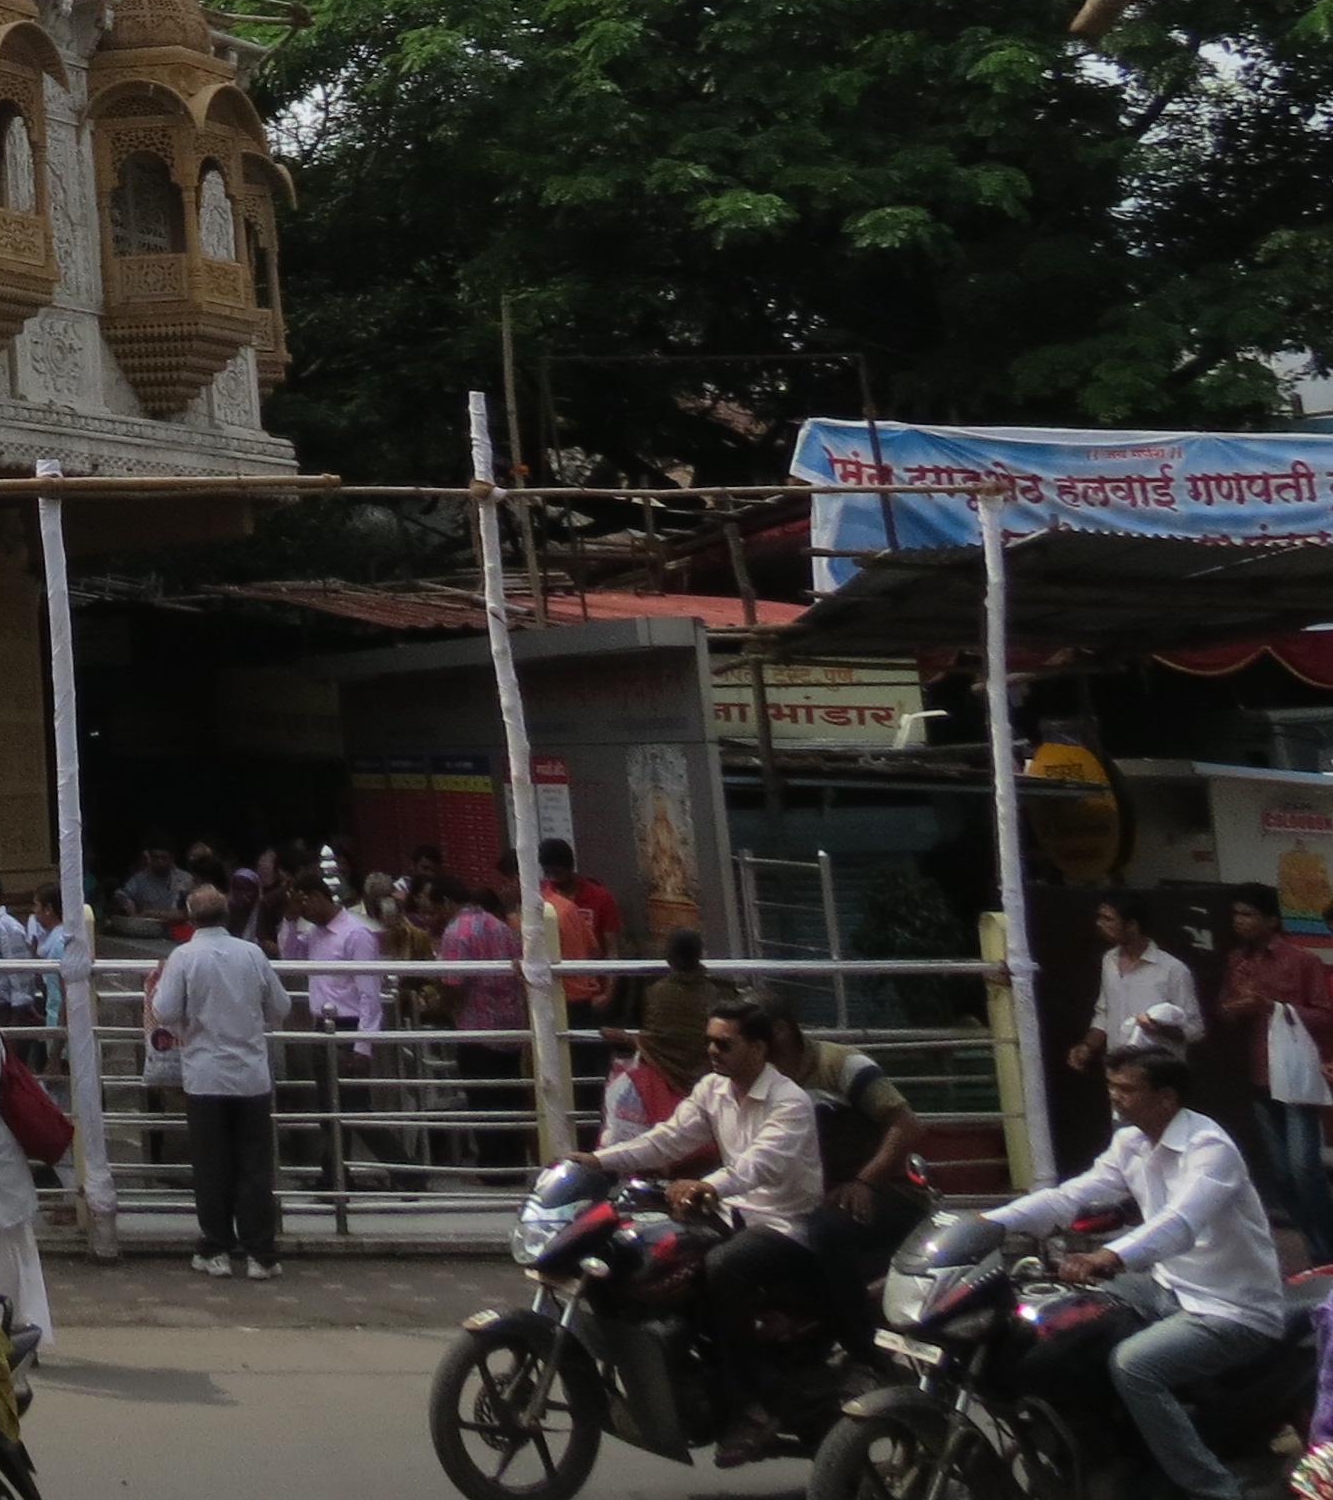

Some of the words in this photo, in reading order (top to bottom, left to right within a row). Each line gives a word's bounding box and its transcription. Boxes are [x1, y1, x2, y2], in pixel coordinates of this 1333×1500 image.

[1055, 464, 1180, 512] हलवाई
[1186, 460, 1317, 506] गणपती
[767, 695, 895, 729] भांडार
